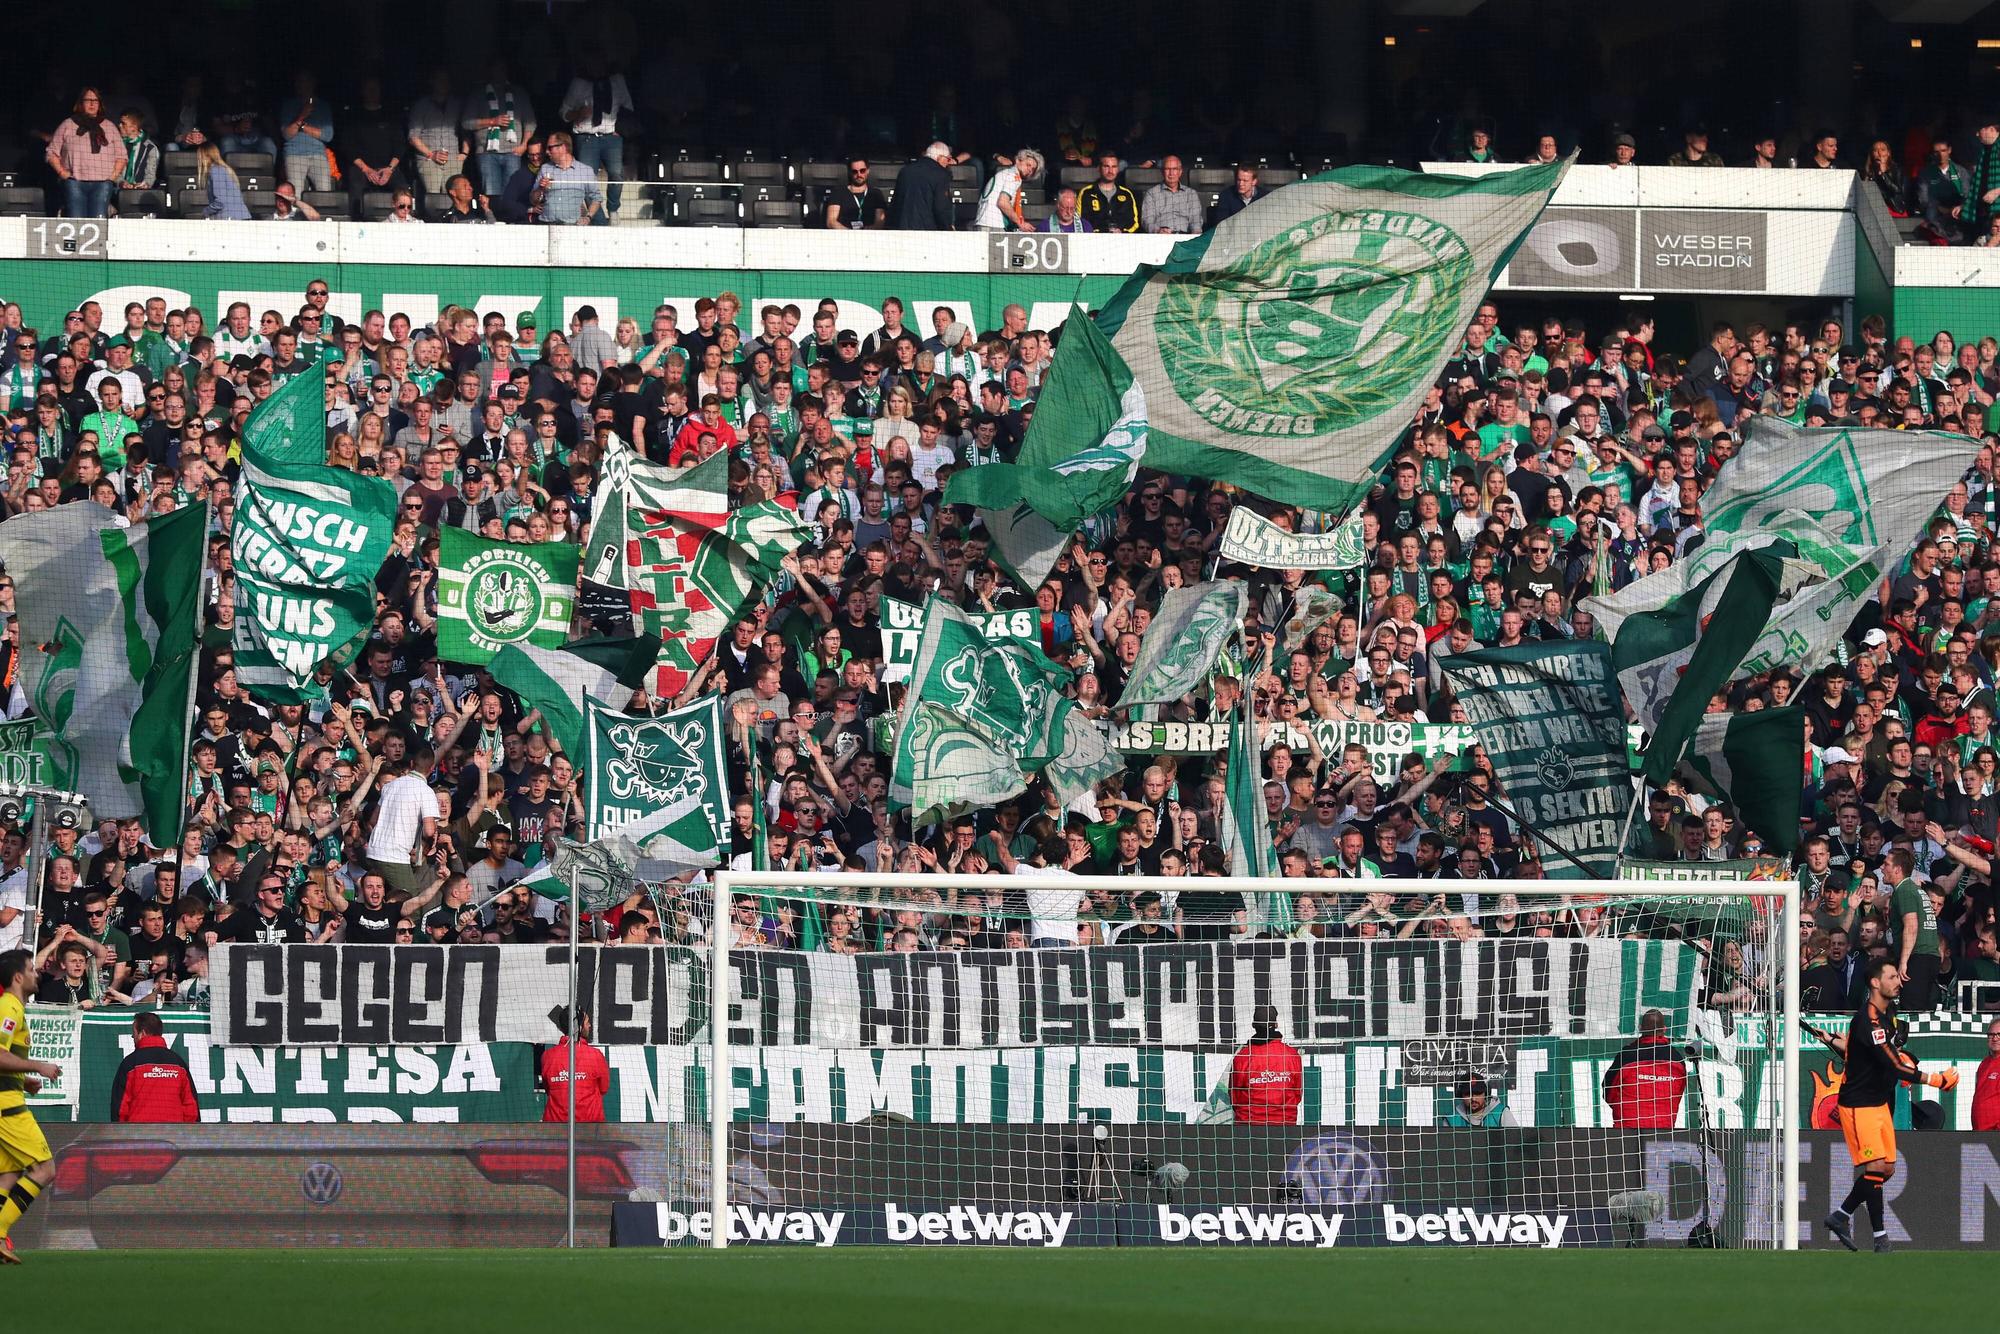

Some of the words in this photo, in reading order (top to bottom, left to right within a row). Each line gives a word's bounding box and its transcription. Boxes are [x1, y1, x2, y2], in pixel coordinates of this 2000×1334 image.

[1091, 198, 1101, 212] 9
[33, 222, 100, 256] 132
[1654, 234, 1752, 250] WESER
[996, 236, 1063, 270] 130
[1656, 253, 1752, 268] STADION
[463, 548, 551, 583] SPORTLICH
[1345, 722, 1386, 747] PRO
[518, 817, 544, 829] JACK
[518, 829, 544, 843] JONE
[228, 944, 501, 1044] GEGEN
[545, 945, 812, 1047] JEDEN
[855, 940, 1590, 1047] ANTISEMITISMUS!
[30, 1018, 76, 1032] MENSCH
[32, 1032, 72, 1045] GESETZ
[29, 1046, 74, 1059] VERBOT
[1405, 1040, 1509, 1065] CIVETTA
[551, 1075, 587, 1083] SECUITY
[1644, 1141, 1913, 1242] DER
[656, 1201, 846, 1247] betway
[884, 1202, 1073, 1247] betway
[1158, 1203, 1345, 1248] betway
[1383, 1203, 1569, 1248] betway
